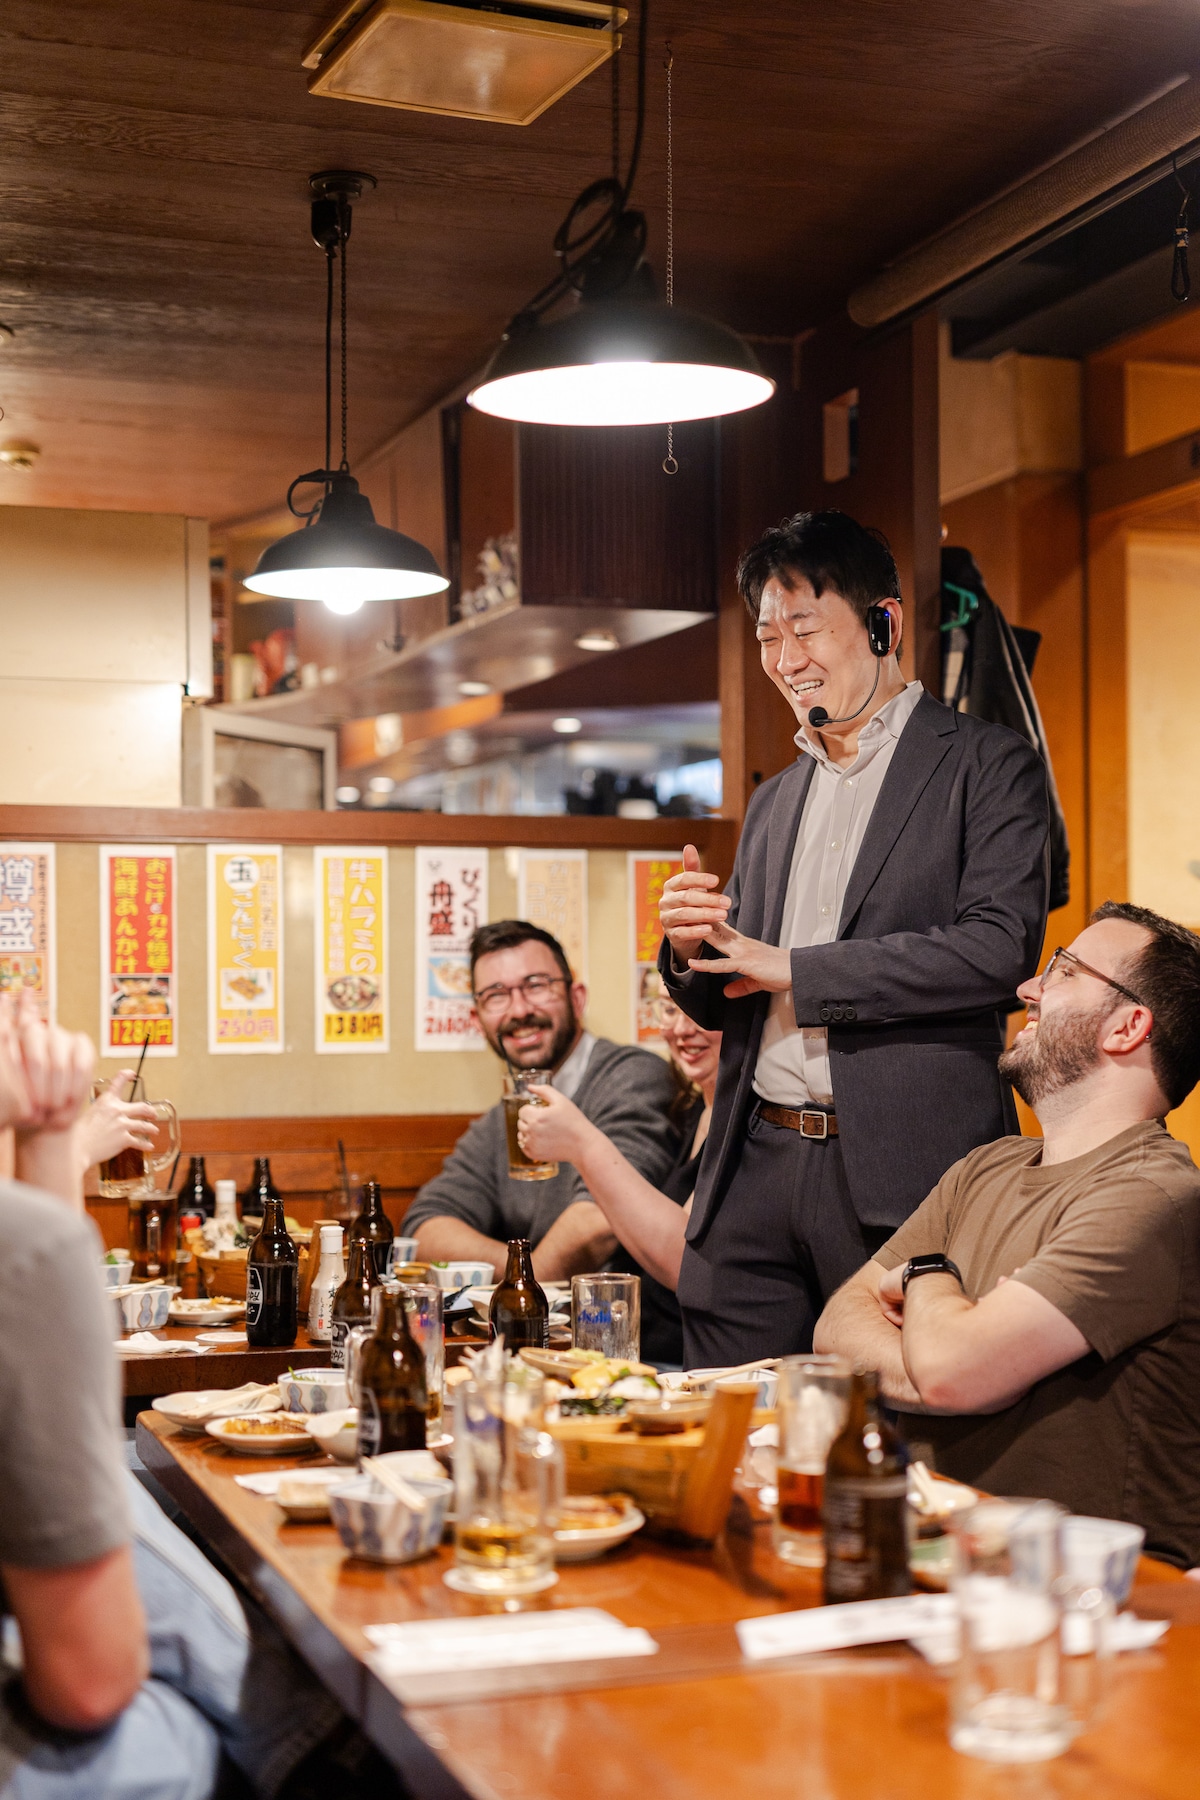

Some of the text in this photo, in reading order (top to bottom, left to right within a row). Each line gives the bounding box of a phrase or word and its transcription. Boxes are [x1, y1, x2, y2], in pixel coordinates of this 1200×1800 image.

[114, 857, 139, 973] 海鮮あんかけ
[228, 858, 257, 970] 玉こんにゃく
[348, 858, 377, 973] 牛ハラミの
[112, 1019, 173, 1044] 1280円
[217, 1018, 275, 1038] 250円
[326, 1014, 382, 1035] 1380円
